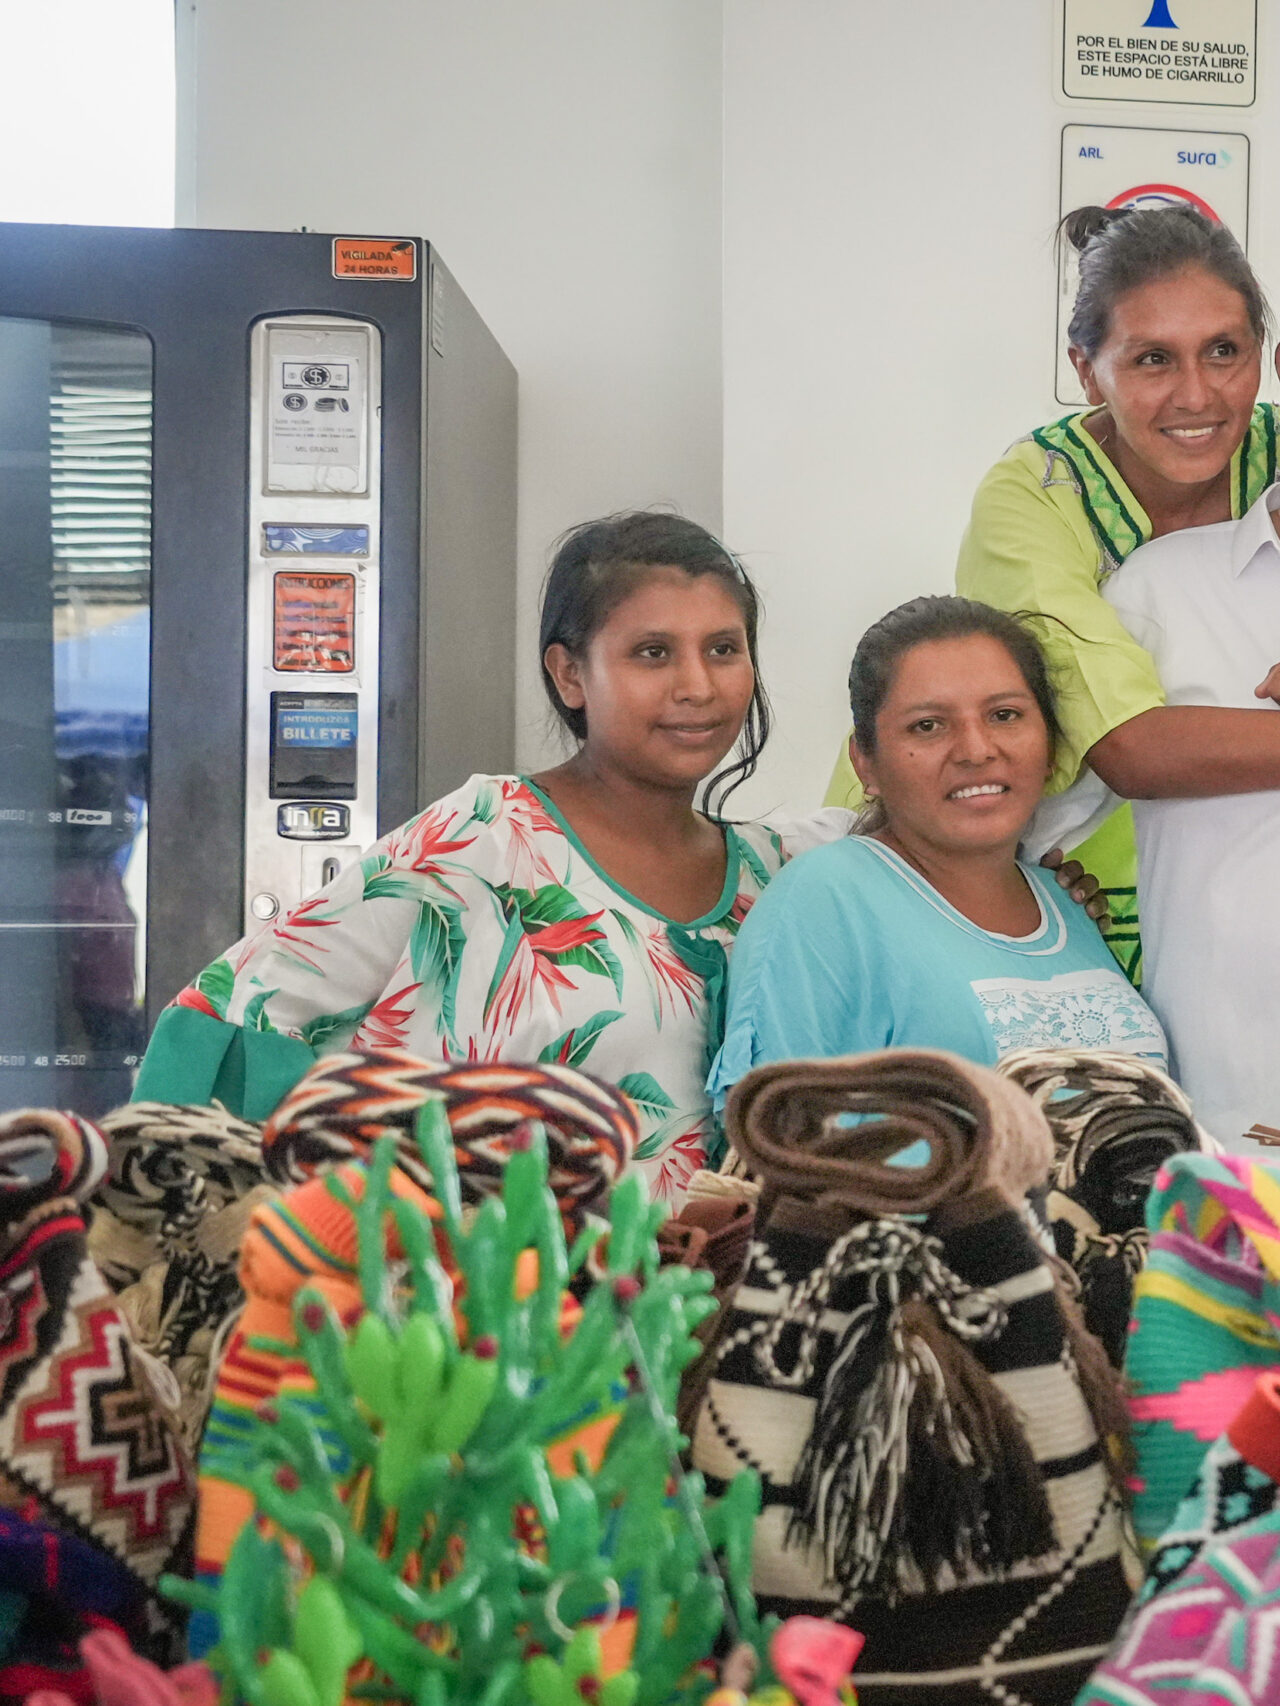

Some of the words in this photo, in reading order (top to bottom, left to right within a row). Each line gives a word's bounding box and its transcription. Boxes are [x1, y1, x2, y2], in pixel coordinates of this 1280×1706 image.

[1076, 35, 1105, 48] POR
[1108, 37, 1124, 48] EL
[1127, 38, 1157, 50] BIEN
[1160, 40, 1179, 52] DE
[1182, 41, 1200, 53] SU
[1203, 43, 1249, 57] SALUD,
[1077, 50, 1111, 63] ESTE
[1115, 52, 1171, 66] ESPACIO
[1174, 53, 1208, 68] ESTÁ
[1211, 57, 1249, 70] LIBRE
[1081, 65, 1099, 76] DE
[1102, 66, 1142, 79] HUMO
[1145, 68, 1164, 80] DE
[1167, 70, 1245, 84] CIGARRILLO
[1078, 146, 1105, 160] ARL
[1177, 151, 1217, 166] sura
[341, 250, 393, 261] VIGILADA
[344, 264, 355, 274] 24
[359, 265, 399, 275] HORAS
[282, 727, 352, 741] BILLETE
[34, 1056, 49, 1067] 48
[123, 1055, 138, 1066] 49
